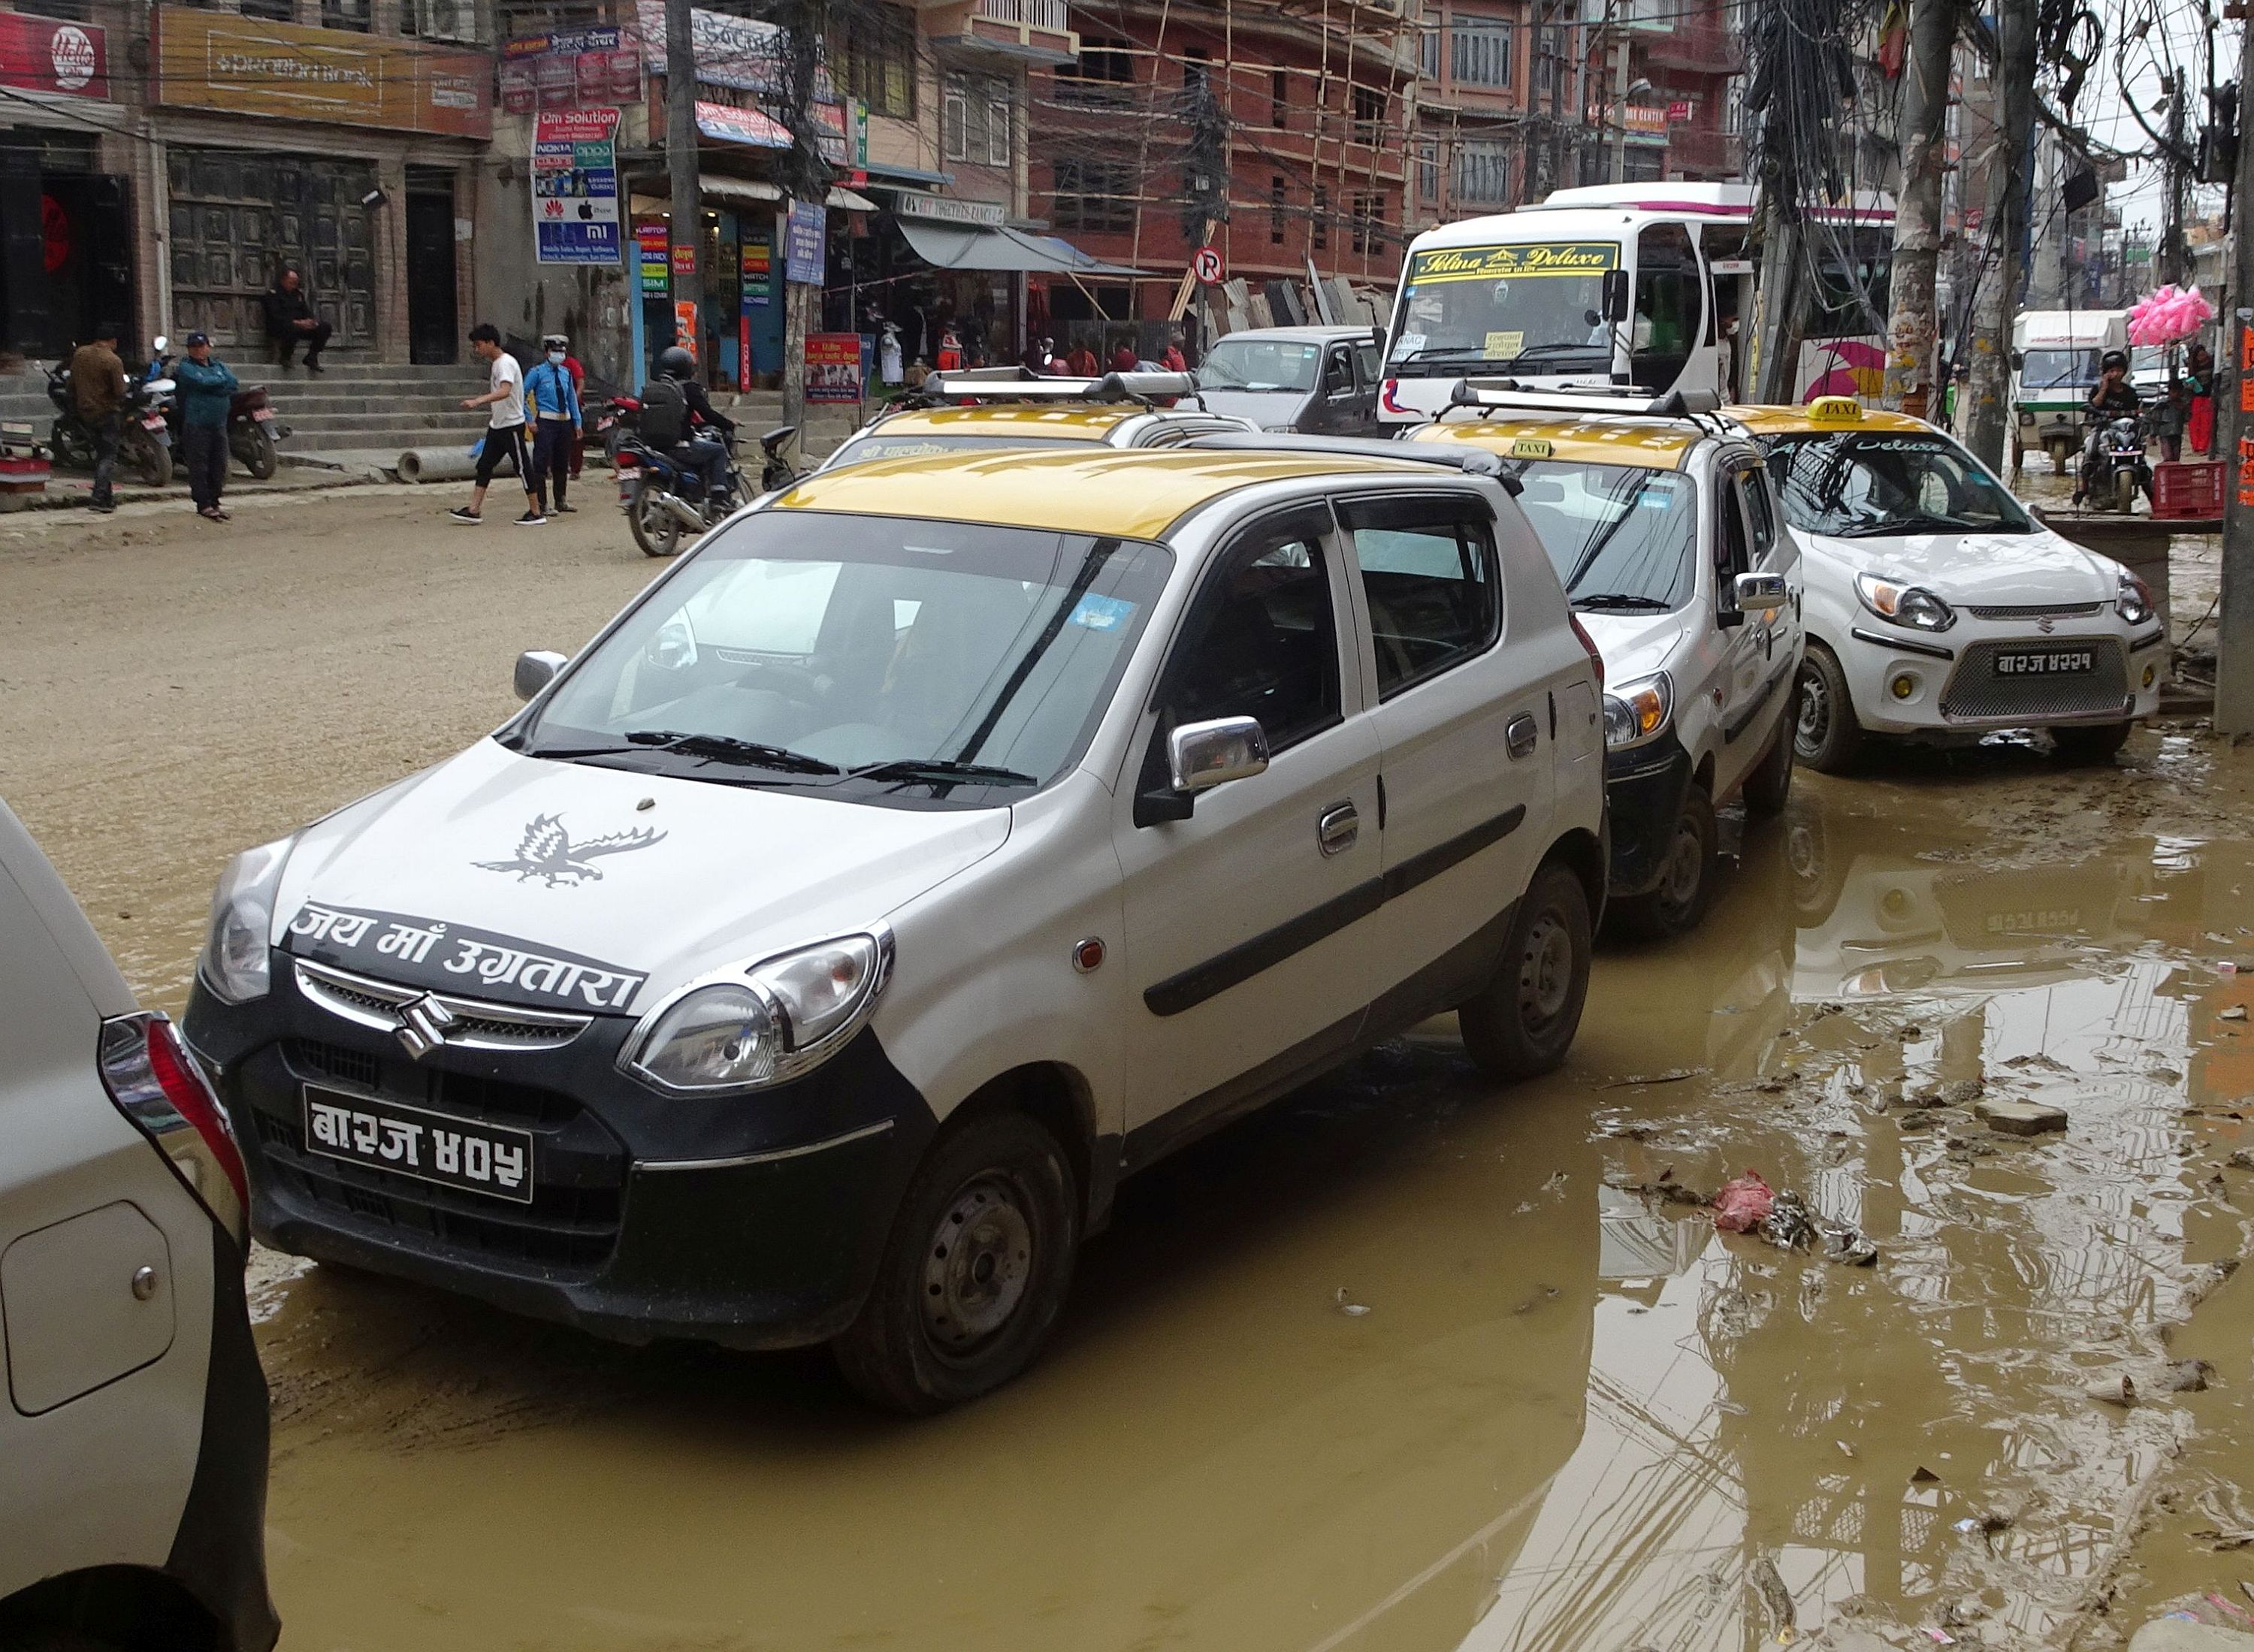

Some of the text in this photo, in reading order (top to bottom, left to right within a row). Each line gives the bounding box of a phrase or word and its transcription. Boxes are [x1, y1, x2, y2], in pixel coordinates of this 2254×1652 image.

[50, 33, 95, 66] Hello
[565, 110, 616, 124] Solution
[537, 143, 572, 153] NOKIA
[919, 198, 933, 214] GET
[1203, 254, 1217, 276] P
[1823, 403, 1858, 415] TAXI
[1519, 443, 1545, 453] TAXI
[290, 904, 644, 1007] जय माँ उग्रतारा
[432, 1128, 523, 1188] ४०५
